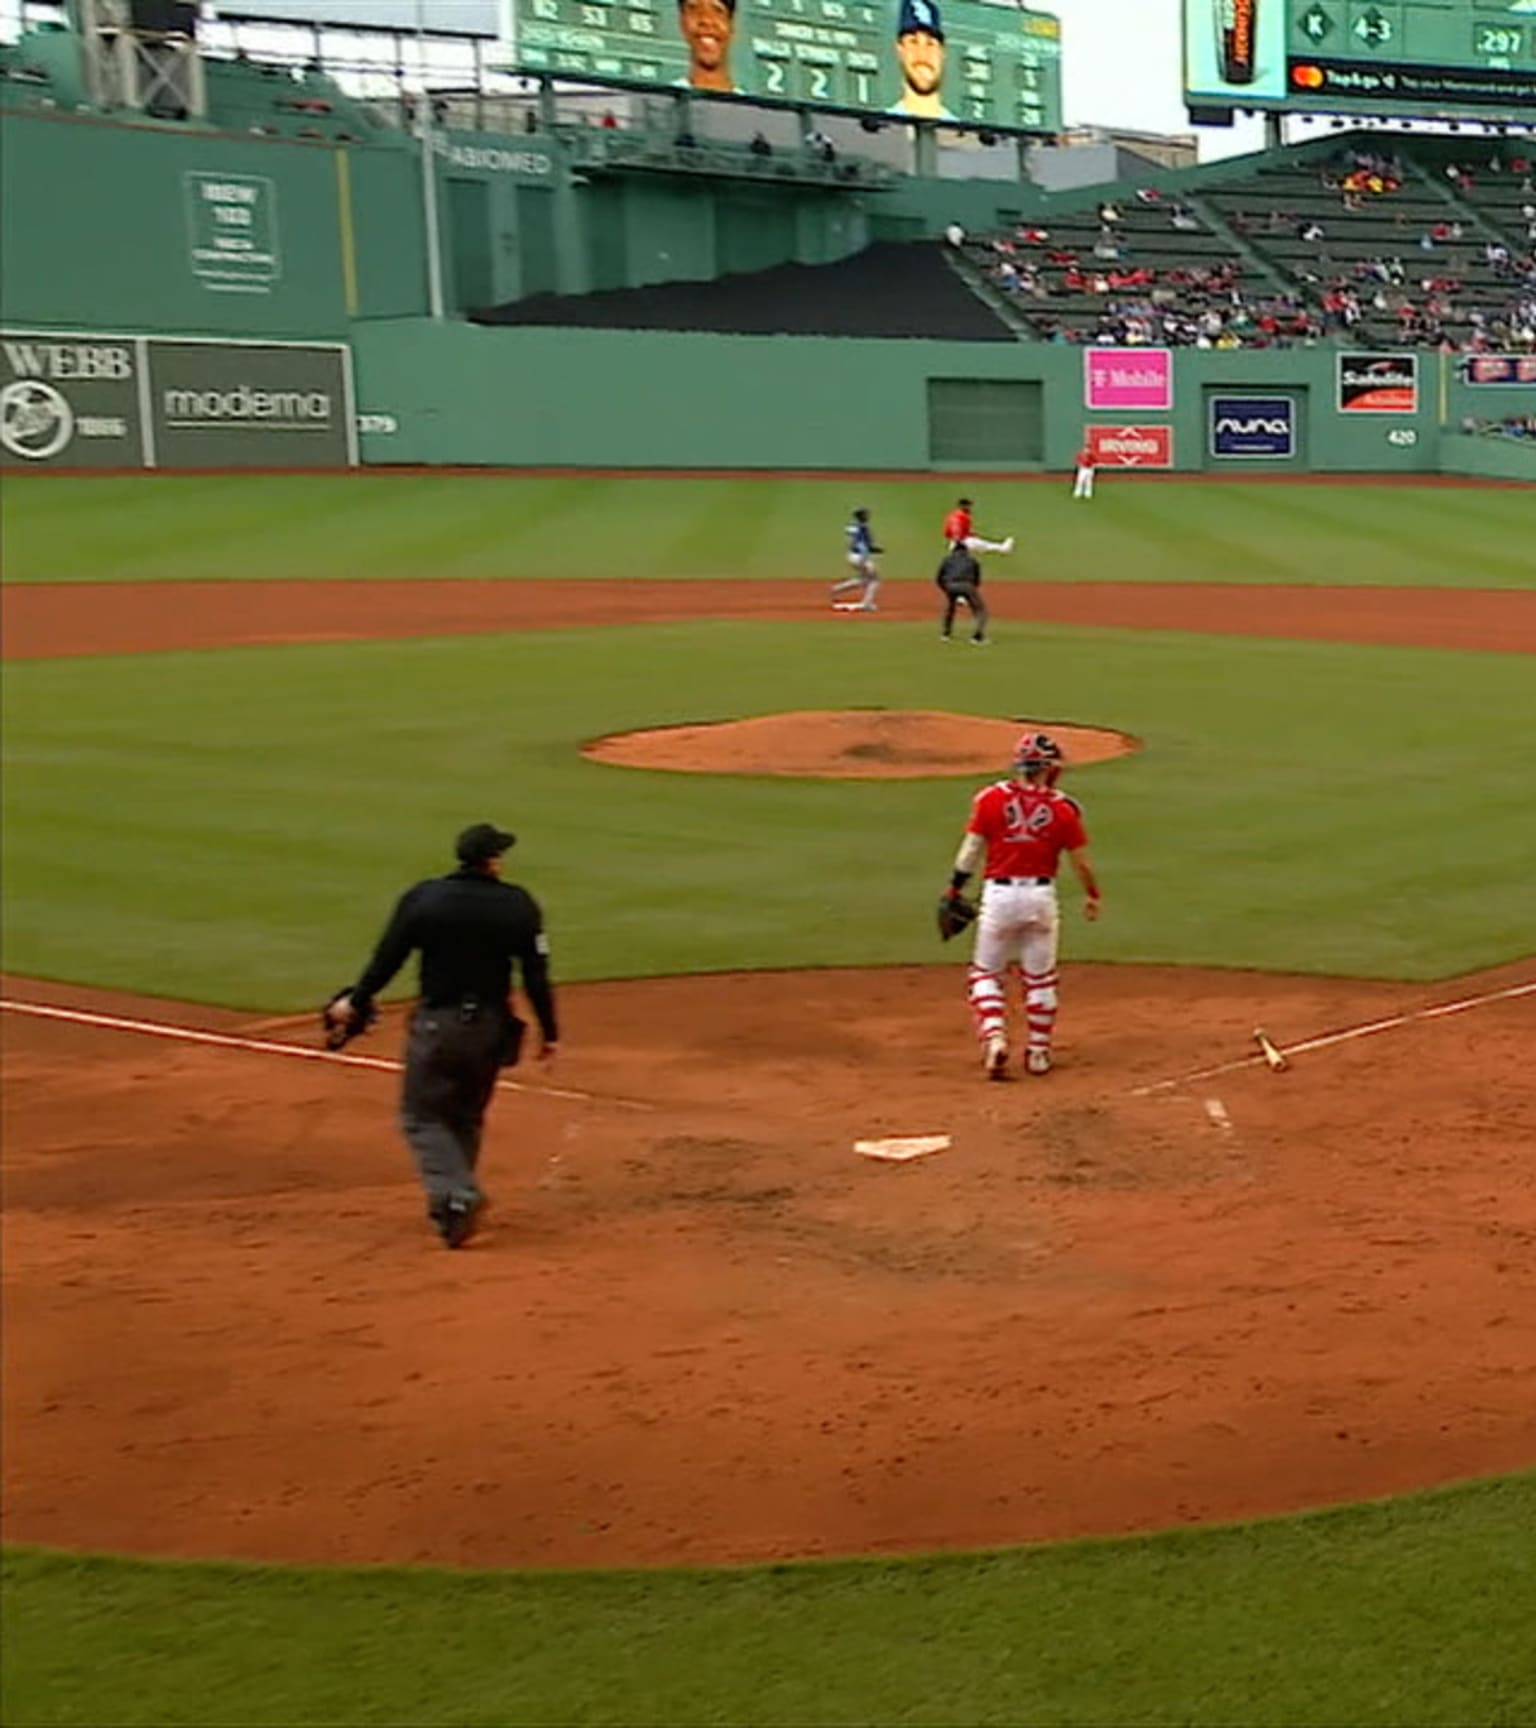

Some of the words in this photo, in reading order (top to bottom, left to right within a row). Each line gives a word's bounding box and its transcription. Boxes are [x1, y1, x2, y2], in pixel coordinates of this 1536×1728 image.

[1354, 16, 1392, 40] 4-3
[1476, 30, 1521, 53] .297
[766, 61, 784, 93] 2
[810, 69, 828, 99] 2
[859, 74, 868, 103] 1
[2, 342, 132, 378] WEBB
[1217, 419, 1288, 434] nuna
[1389, 430, 1416, 444] 420
